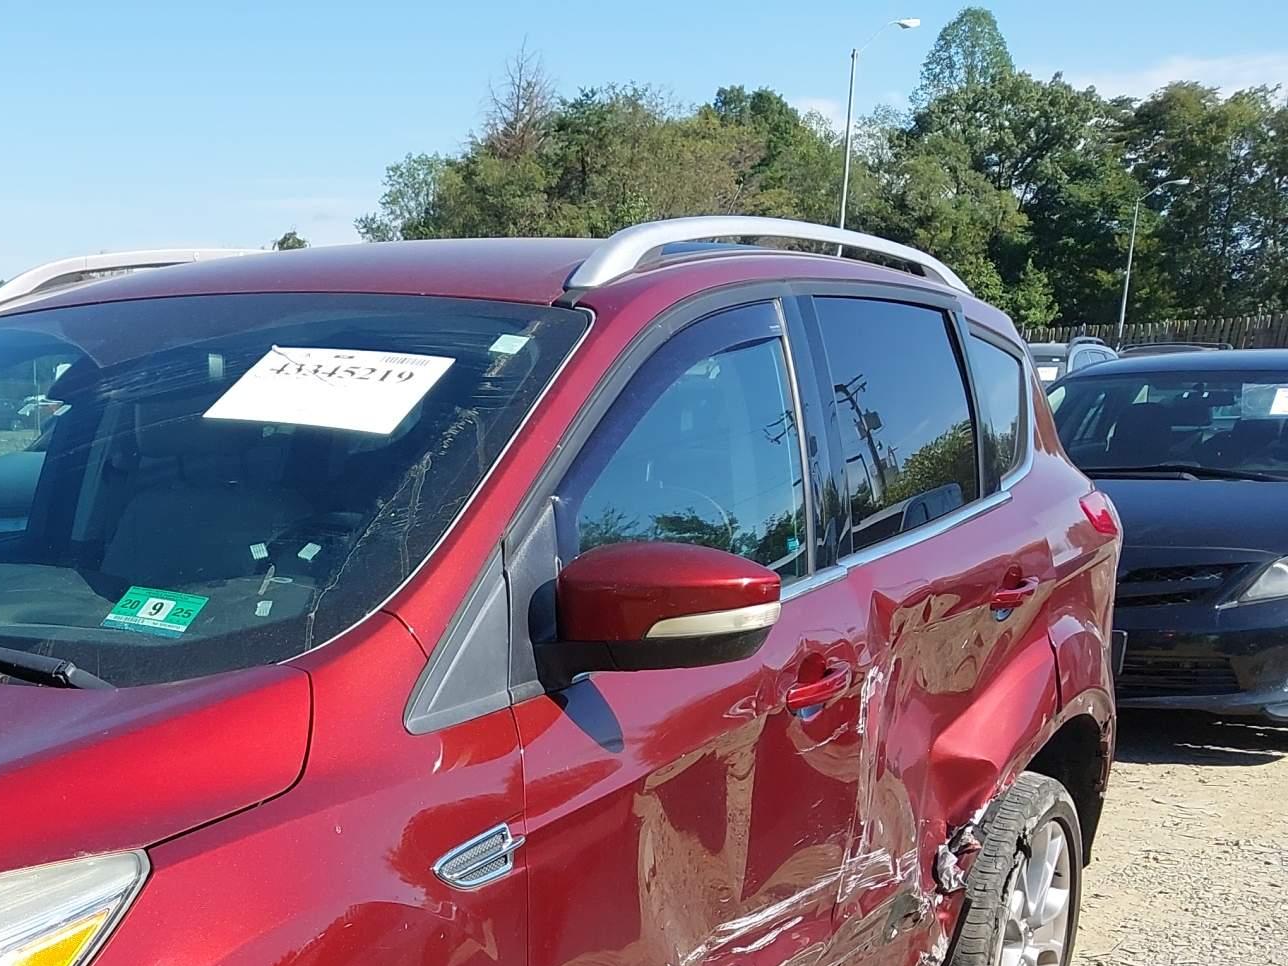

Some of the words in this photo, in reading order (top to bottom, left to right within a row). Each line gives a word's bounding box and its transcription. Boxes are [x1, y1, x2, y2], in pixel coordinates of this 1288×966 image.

[269, 363, 415, 382] 43345219
[121, 599, 142, 610] 20
[149, 602, 165, 616] 9
[172, 608, 194, 619] 25
